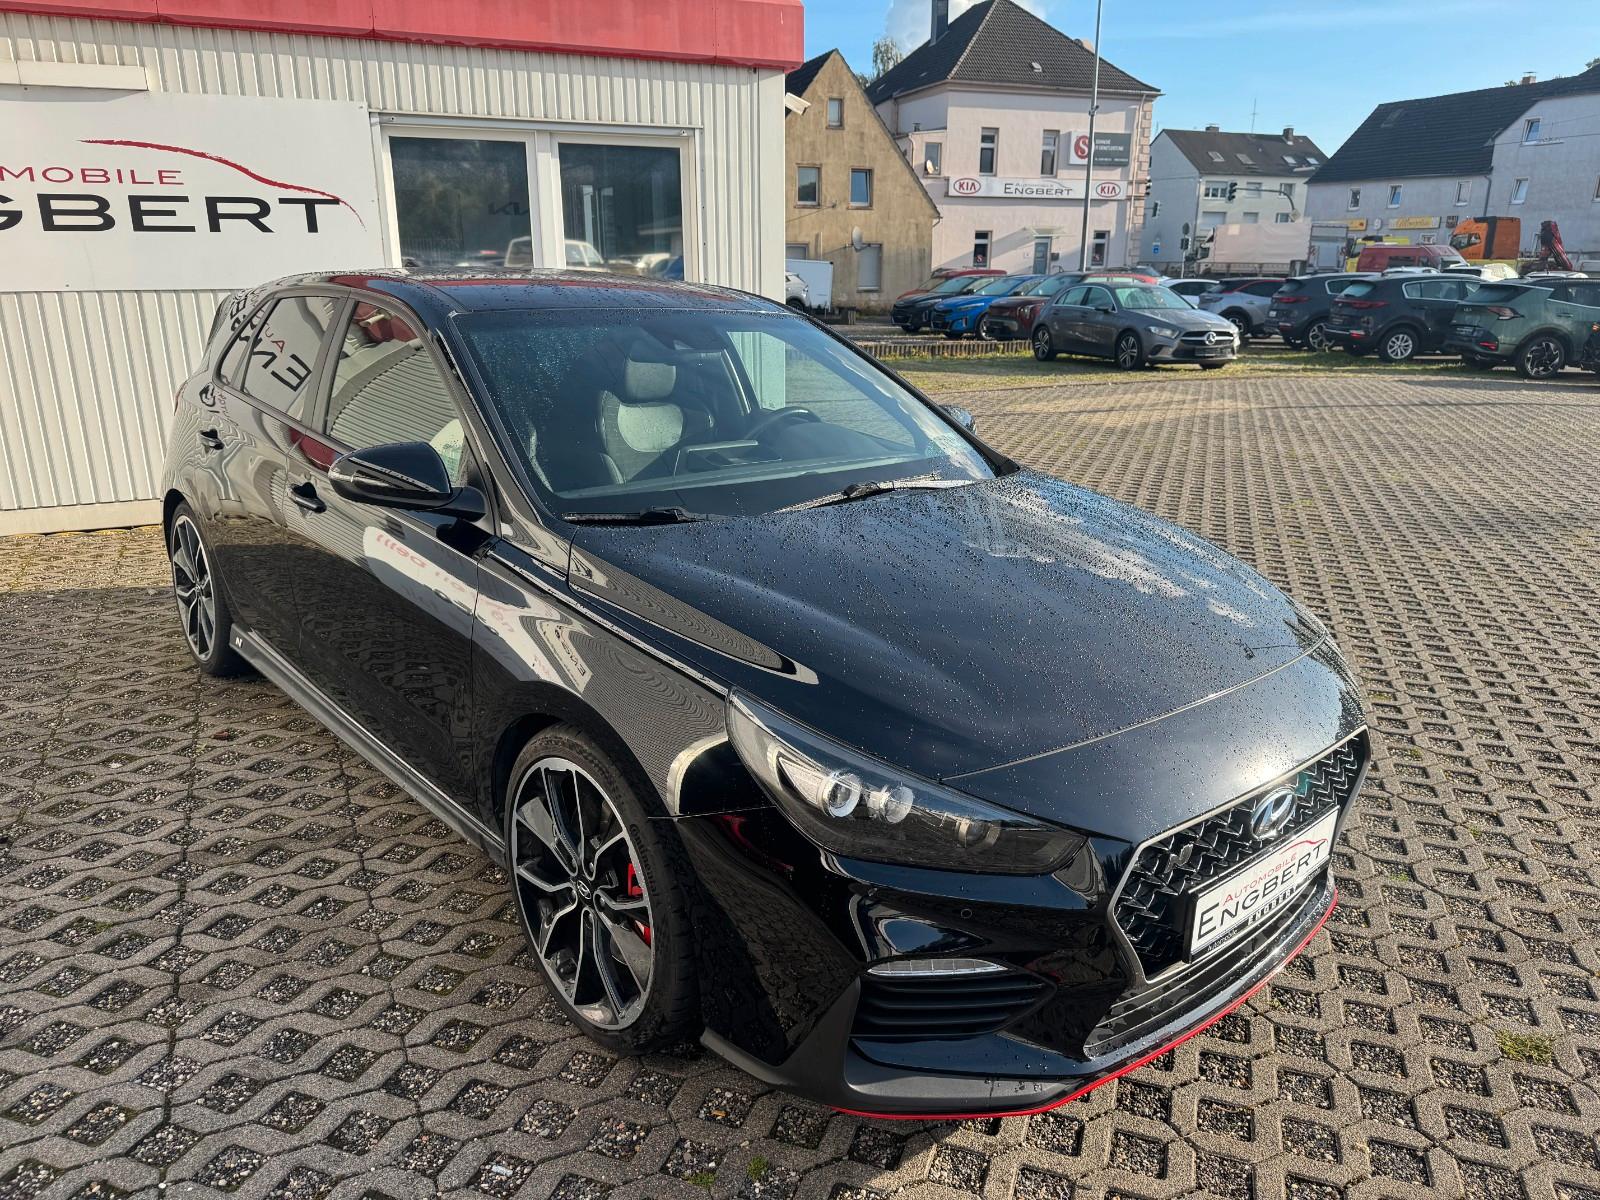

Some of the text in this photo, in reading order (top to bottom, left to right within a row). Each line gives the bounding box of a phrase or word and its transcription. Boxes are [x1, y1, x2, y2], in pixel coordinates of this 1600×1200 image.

[0, 167, 184, 185] MOBILE
[958, 180, 976, 192] KIA
[1004, 183, 1073, 196] ENGBERT
[1100, 185, 1116, 195] KIA
[0, 193, 340, 233] BERT
[1222, 852, 1297, 906] AUTOMOBILE
[1197, 840, 1326, 941] ENGBERT
